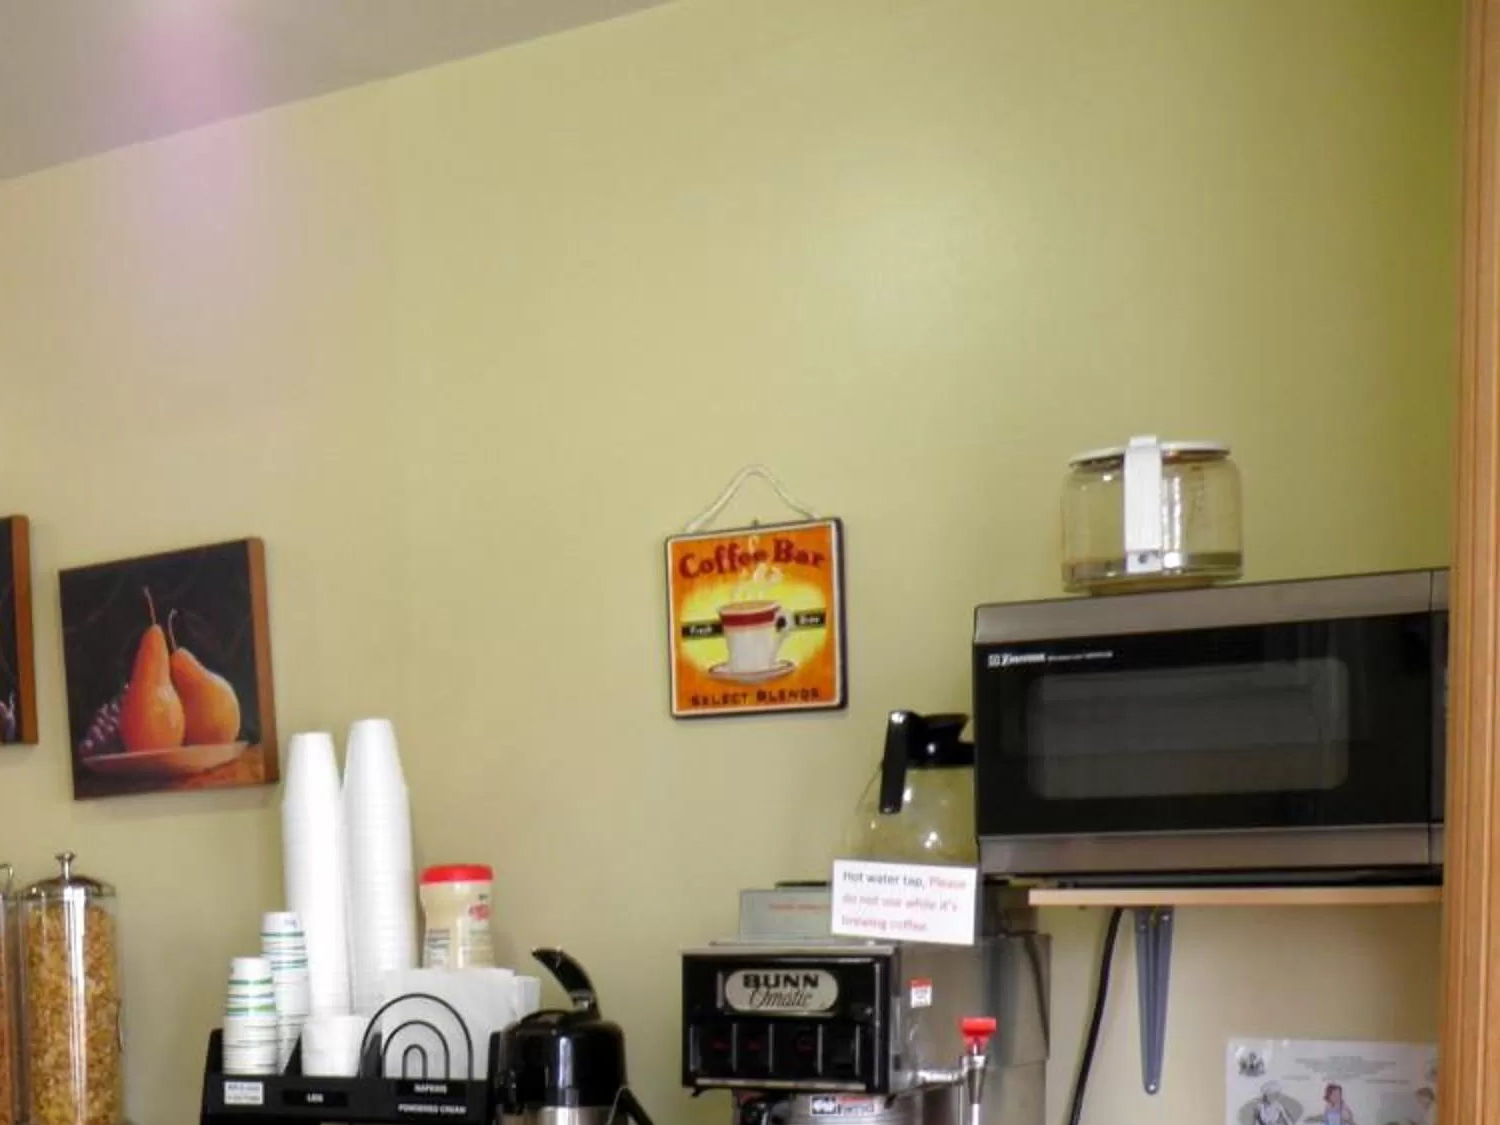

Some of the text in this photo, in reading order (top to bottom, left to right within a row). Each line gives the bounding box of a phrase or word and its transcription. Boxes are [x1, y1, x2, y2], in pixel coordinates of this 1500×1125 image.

[679, 538, 825, 578] Coffee Bar
[691, 687, 820, 706] SELECT BLENDS
[842, 871, 864, 883] Hot
[867, 874, 899, 885] water
[902, 875, 925, 889] tap,
[742, 974, 819, 988] BUNN
